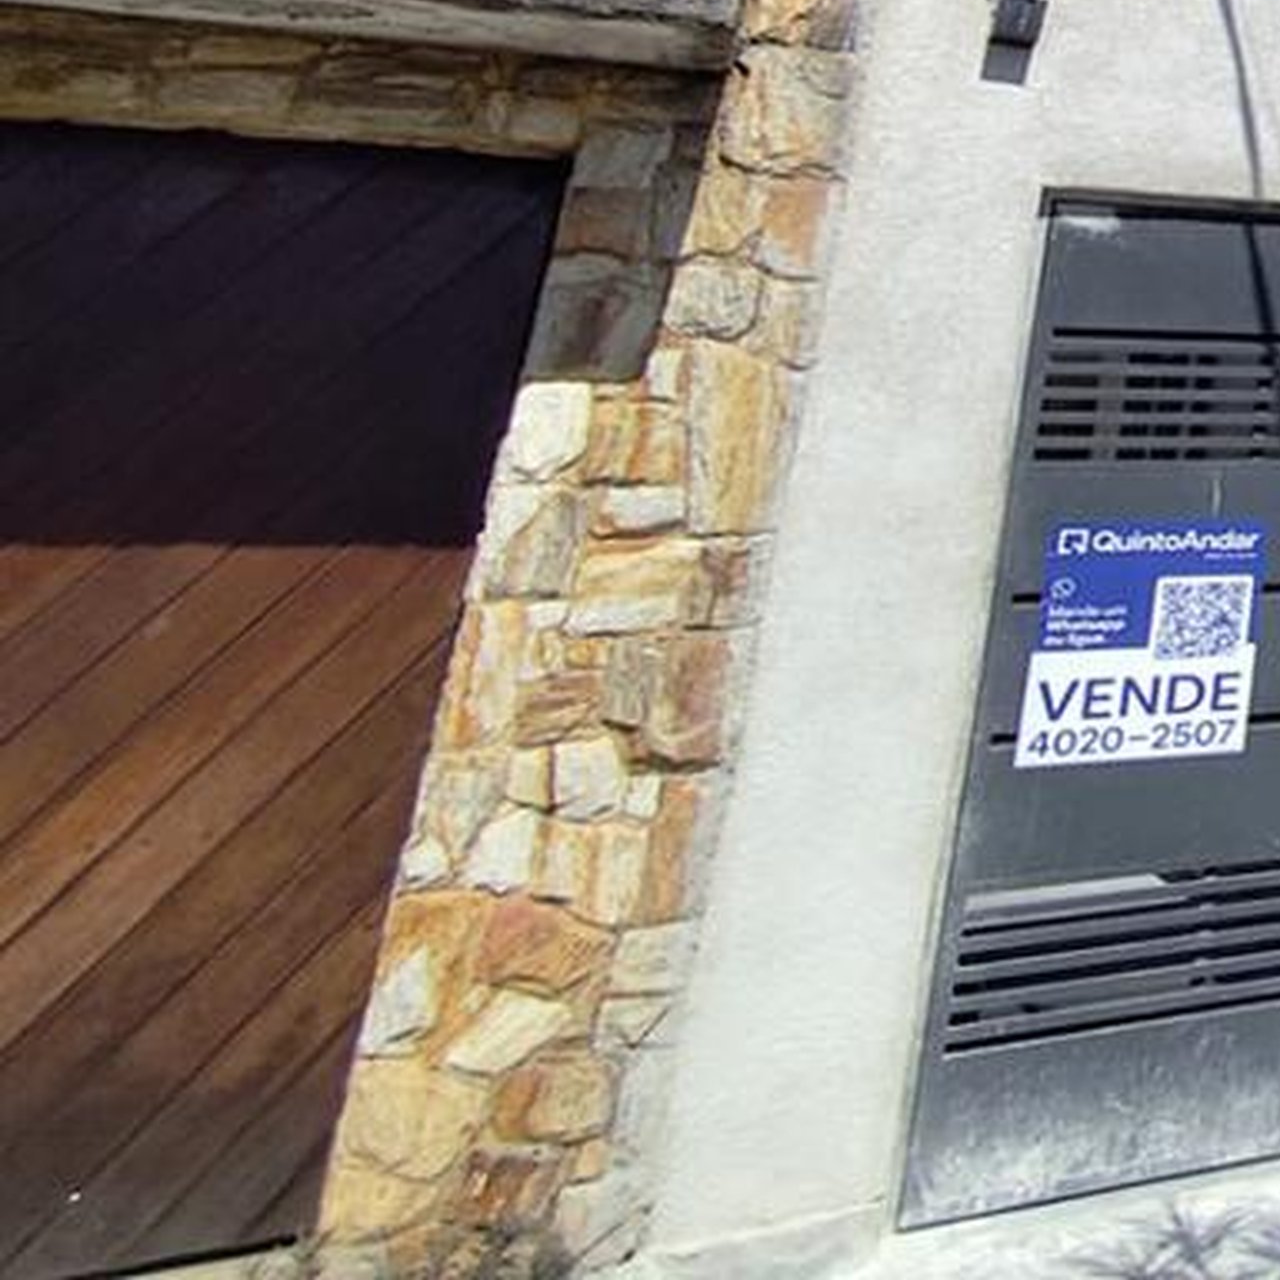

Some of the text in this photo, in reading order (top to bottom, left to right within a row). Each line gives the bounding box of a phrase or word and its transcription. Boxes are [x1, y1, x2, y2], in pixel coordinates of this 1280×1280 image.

[1092, 529, 1260, 553] QuintoAndar
[1039, 672, 1242, 722] VENDE
[1027, 719, 1237, 758] 4020-2507
